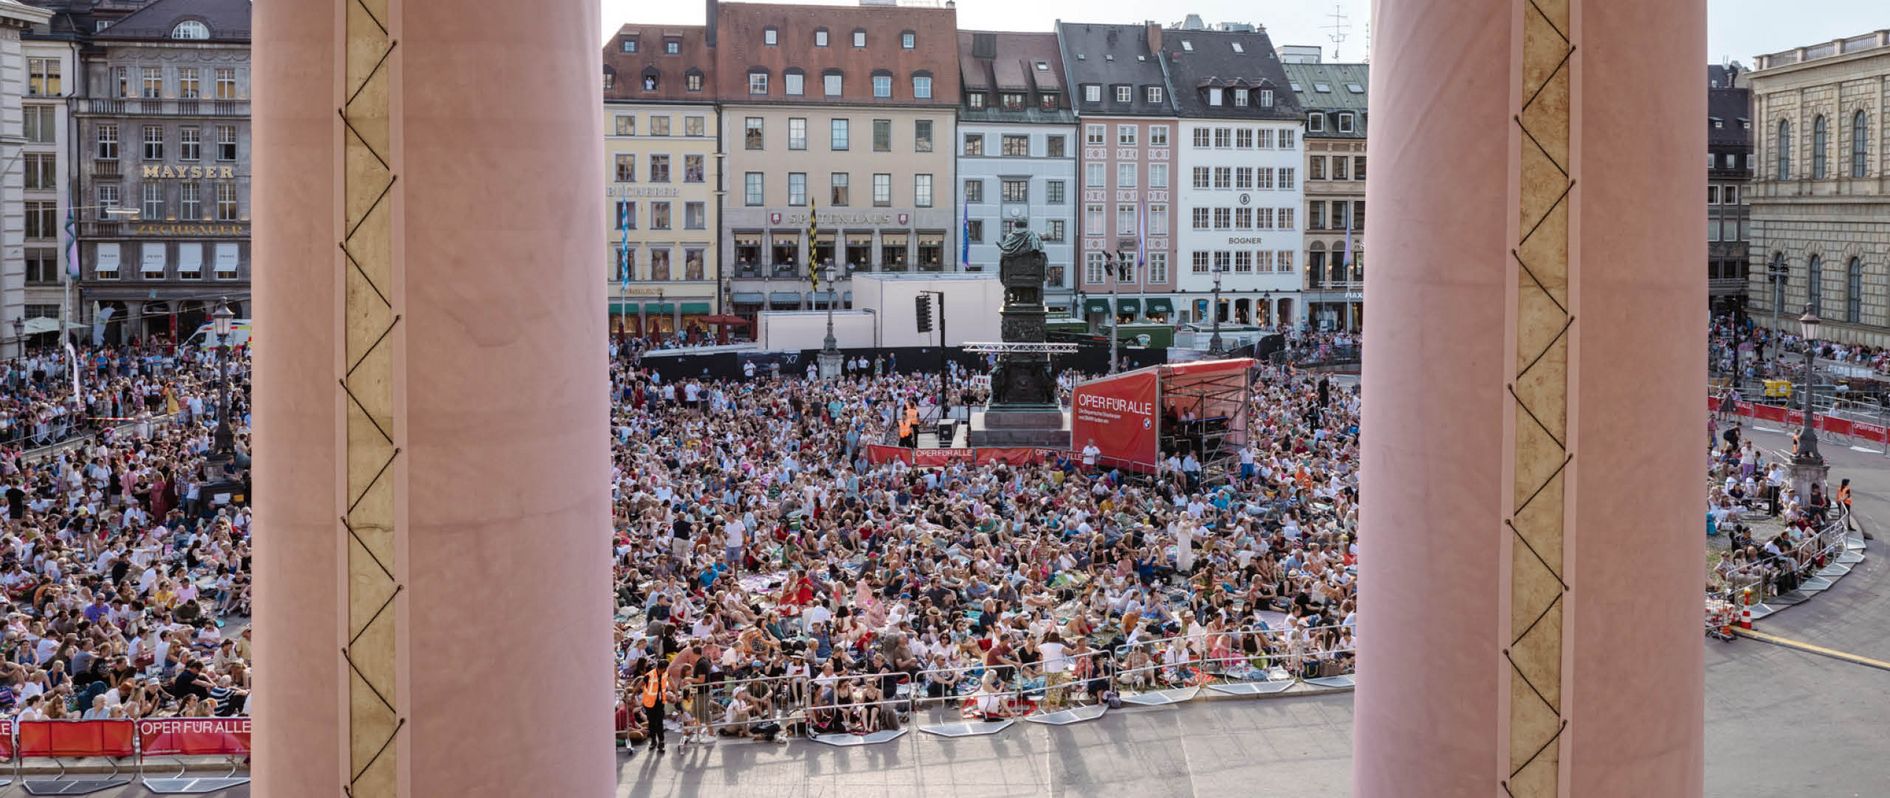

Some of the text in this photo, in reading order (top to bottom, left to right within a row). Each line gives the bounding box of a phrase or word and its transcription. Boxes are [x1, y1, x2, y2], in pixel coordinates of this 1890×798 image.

[143, 165, 234, 178] MAYSER
[789, 214, 891, 224] SPTENHAUS
[1228, 237, 1262, 245] BOGNER
[786, 354, 798, 365] X7
[1078, 393, 1105, 409] OPER
[1127, 400, 1152, 415] ALLE
[140, 721, 251, 735] OPER FÜR ALLE
